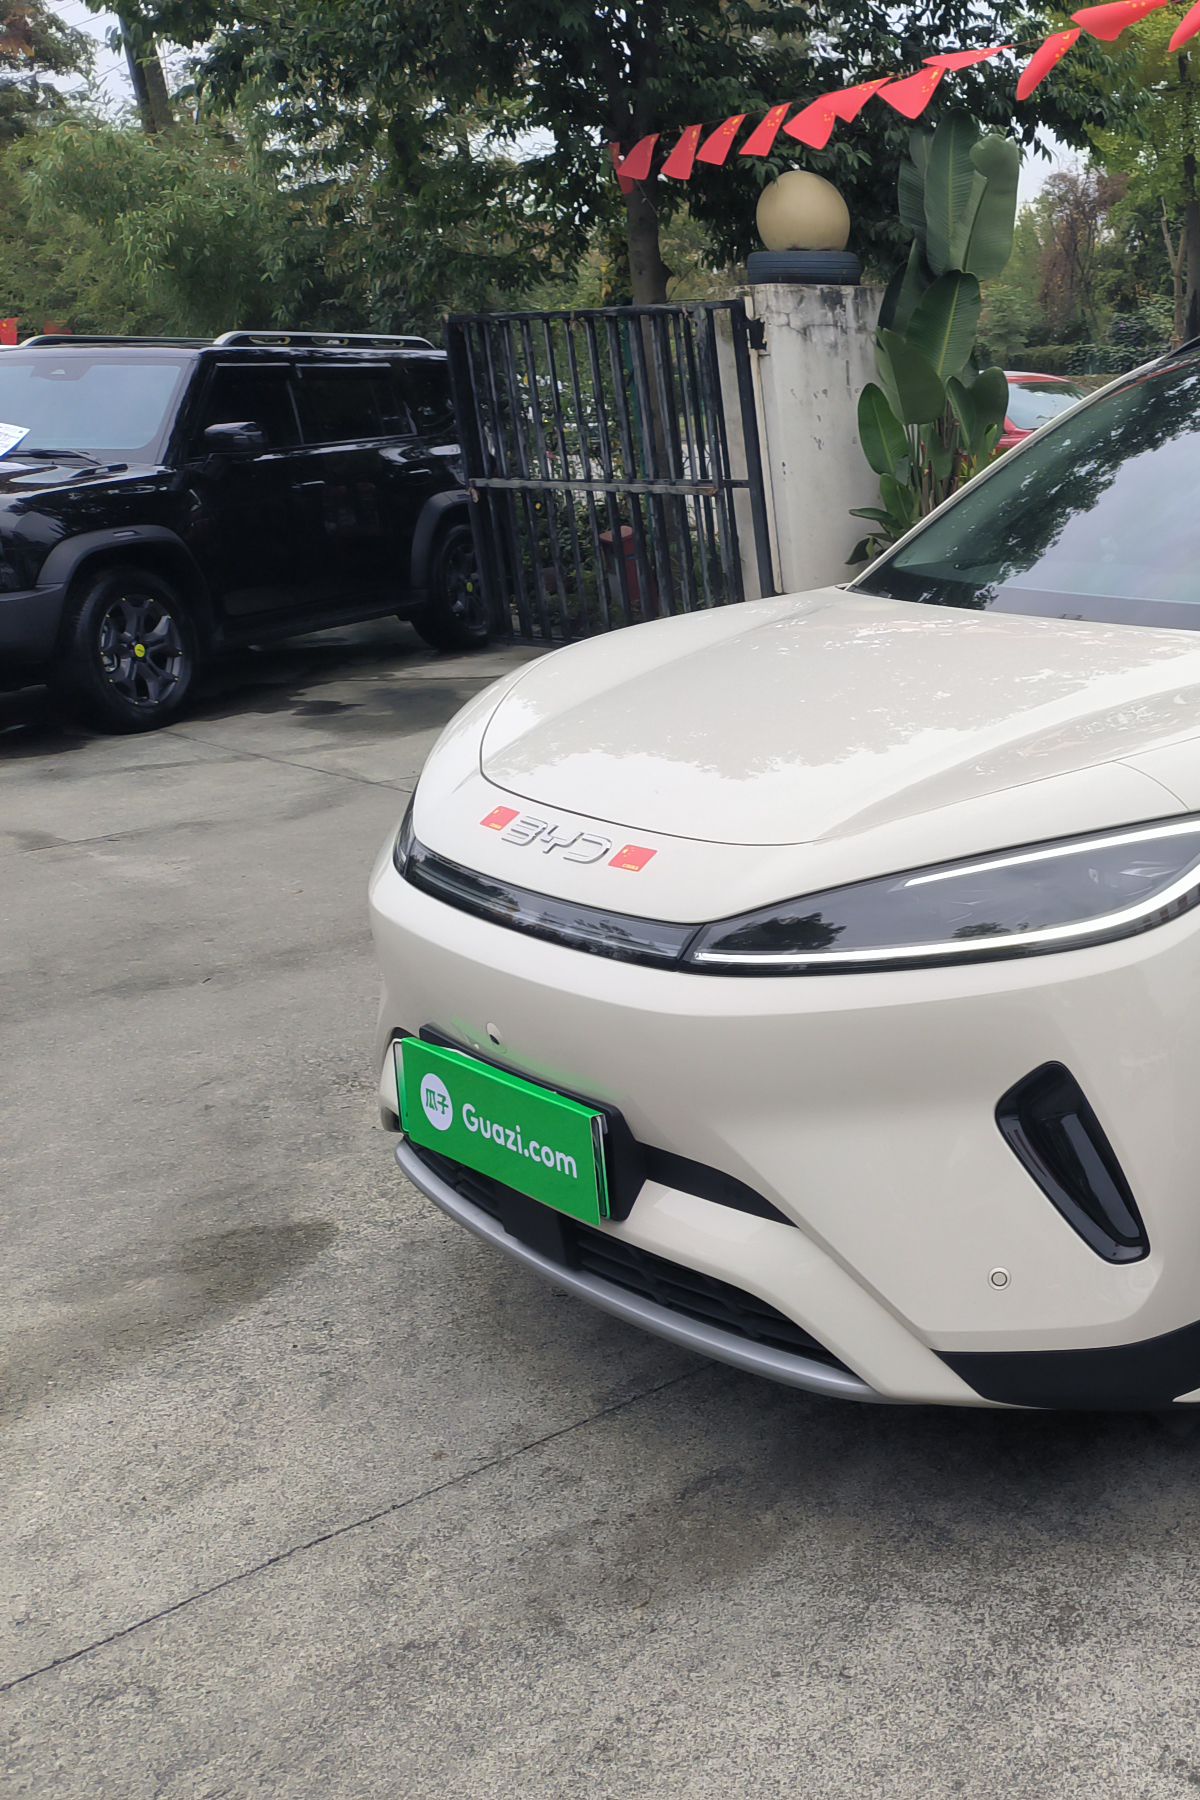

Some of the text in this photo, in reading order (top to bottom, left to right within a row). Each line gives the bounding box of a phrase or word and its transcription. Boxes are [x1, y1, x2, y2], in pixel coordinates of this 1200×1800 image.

[500, 815, 613, 864] BYD
[425, 1087, 449, 1115] 瓜子
[462, 1103, 578, 1179] Guazi.com
